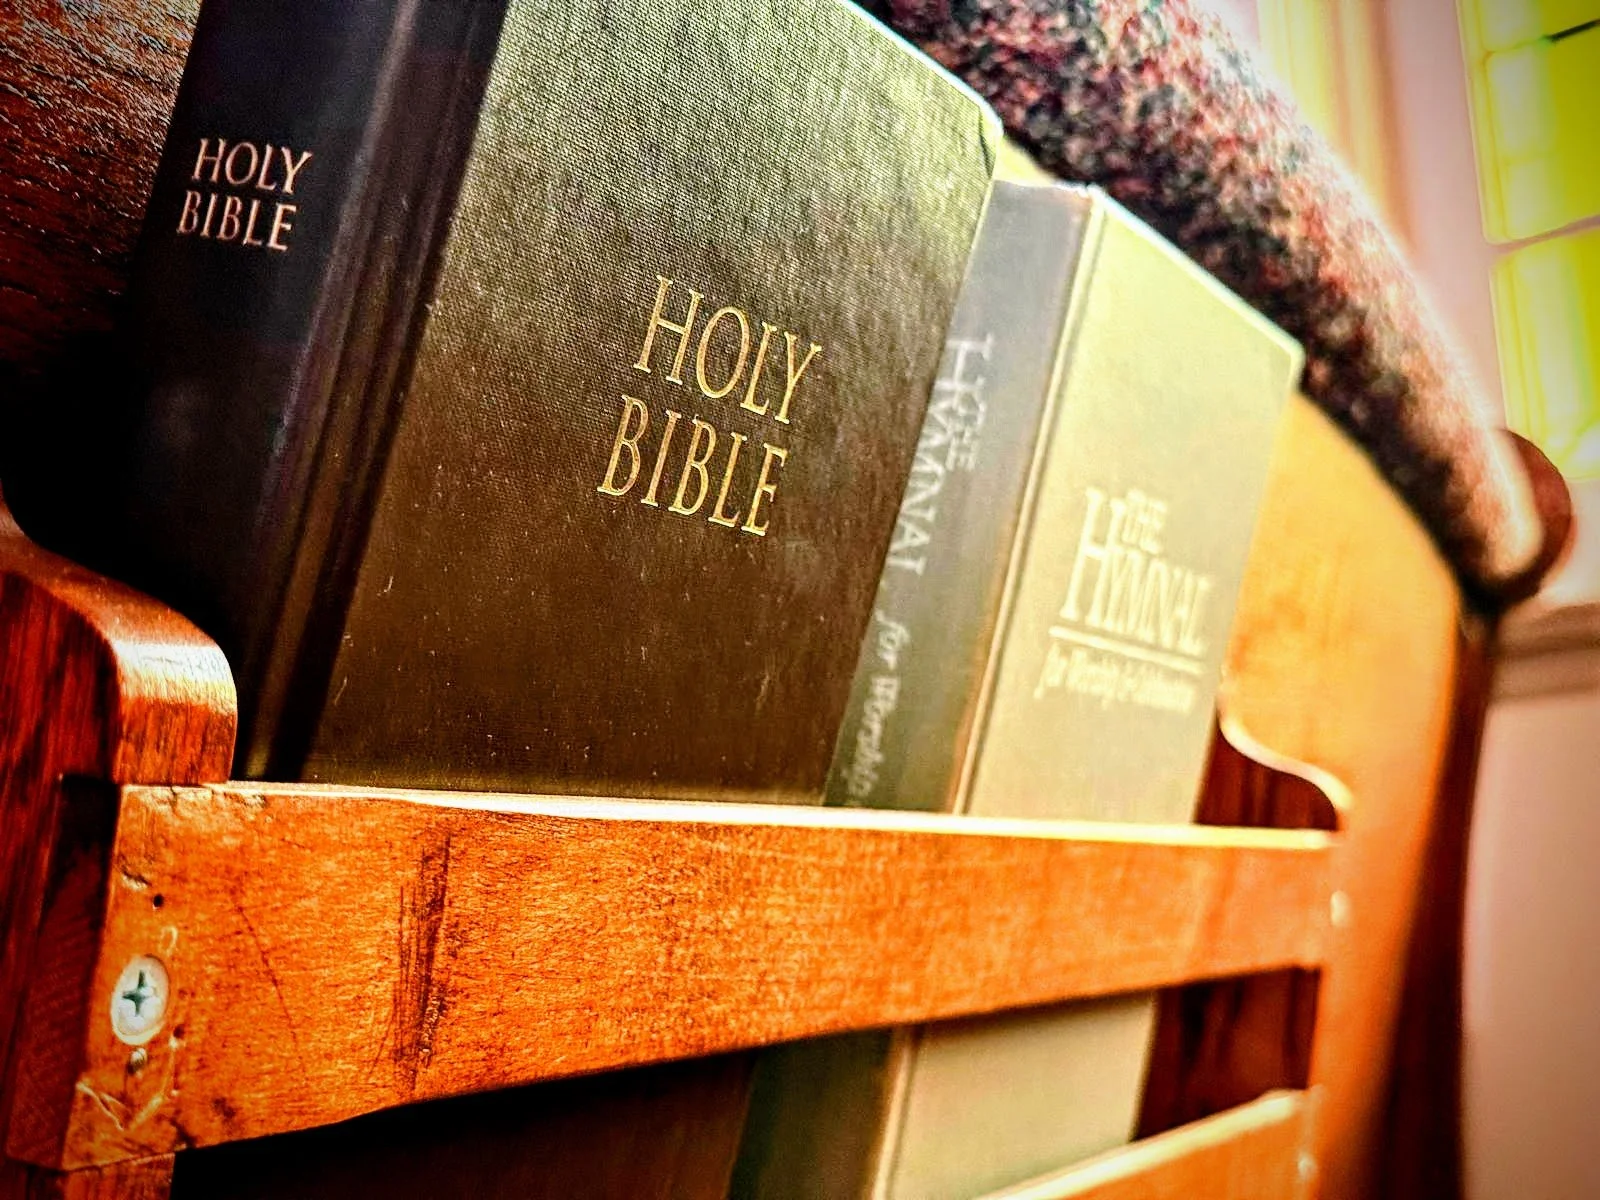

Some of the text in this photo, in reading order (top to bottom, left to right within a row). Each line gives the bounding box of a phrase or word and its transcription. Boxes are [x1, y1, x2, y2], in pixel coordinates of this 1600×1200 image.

[175, 189, 297, 251] BIBLE
[191, 137, 313, 195] HOLY
[633, 274, 823, 425] HOLY
[596, 394, 789, 537] BIBLE
[1059, 486, 1213, 657] HYMNAL
